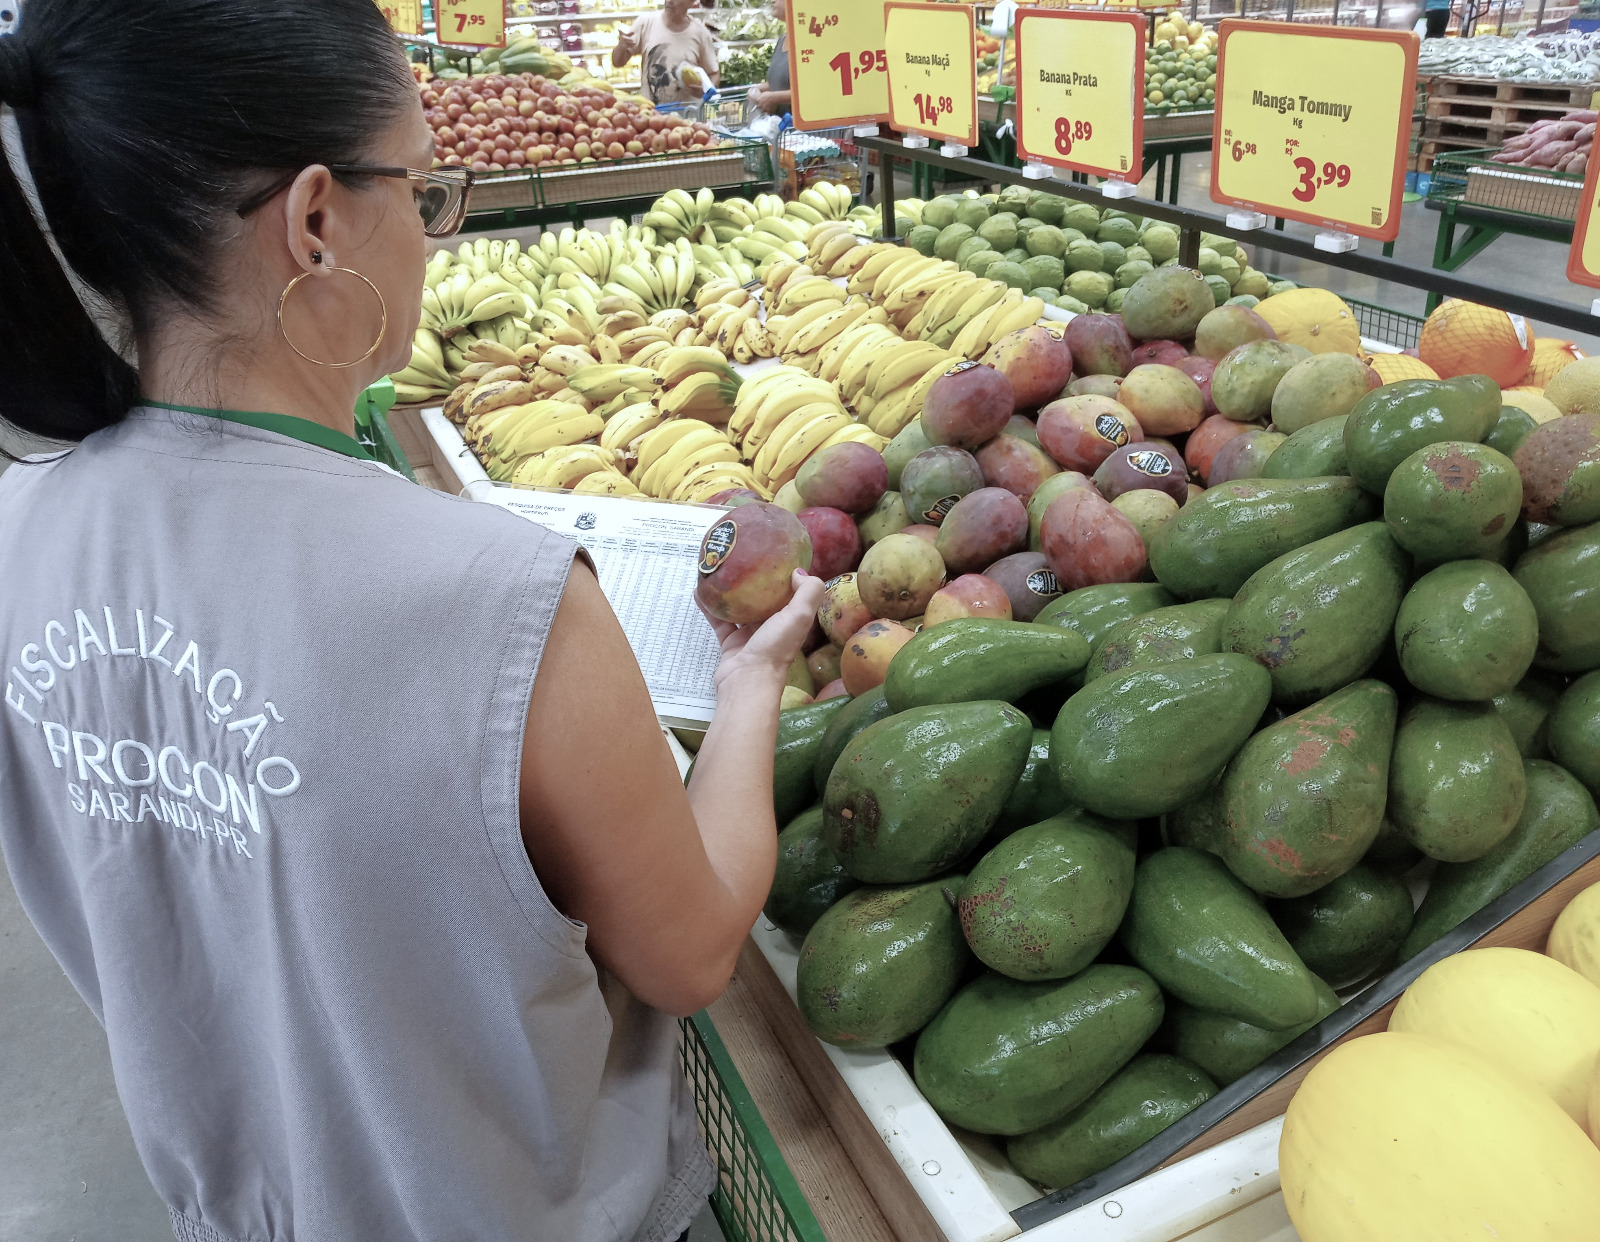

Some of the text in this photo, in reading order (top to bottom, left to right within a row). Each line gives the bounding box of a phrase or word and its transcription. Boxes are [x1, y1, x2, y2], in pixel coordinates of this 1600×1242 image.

[454, 13, 485, 33] 7,95
[808, 14, 839, 37] 4,49
[829, 49, 888, 96] 1,95
[905, 52, 950, 71] Banana Maçã
[1039, 69, 1098, 88] Banana Prata
[913, 93, 953, 127] 14,98
[1252, 89, 1352, 123] Manga Tommy
[1054, 116, 1093, 156] 8,89
[1292, 117, 1303, 129] Kg
[1231, 140, 1257, 163] 6,98
[1284, 147, 1293, 157] R$
[1285, 138, 1300, 147] POR:
[1291, 156, 1352, 203] 3,99
[4, 605, 302, 797] FISCALIZAÇÃO
[42, 720, 261, 835] PROCON
[68, 782, 253, 860] SARANDI-PR
